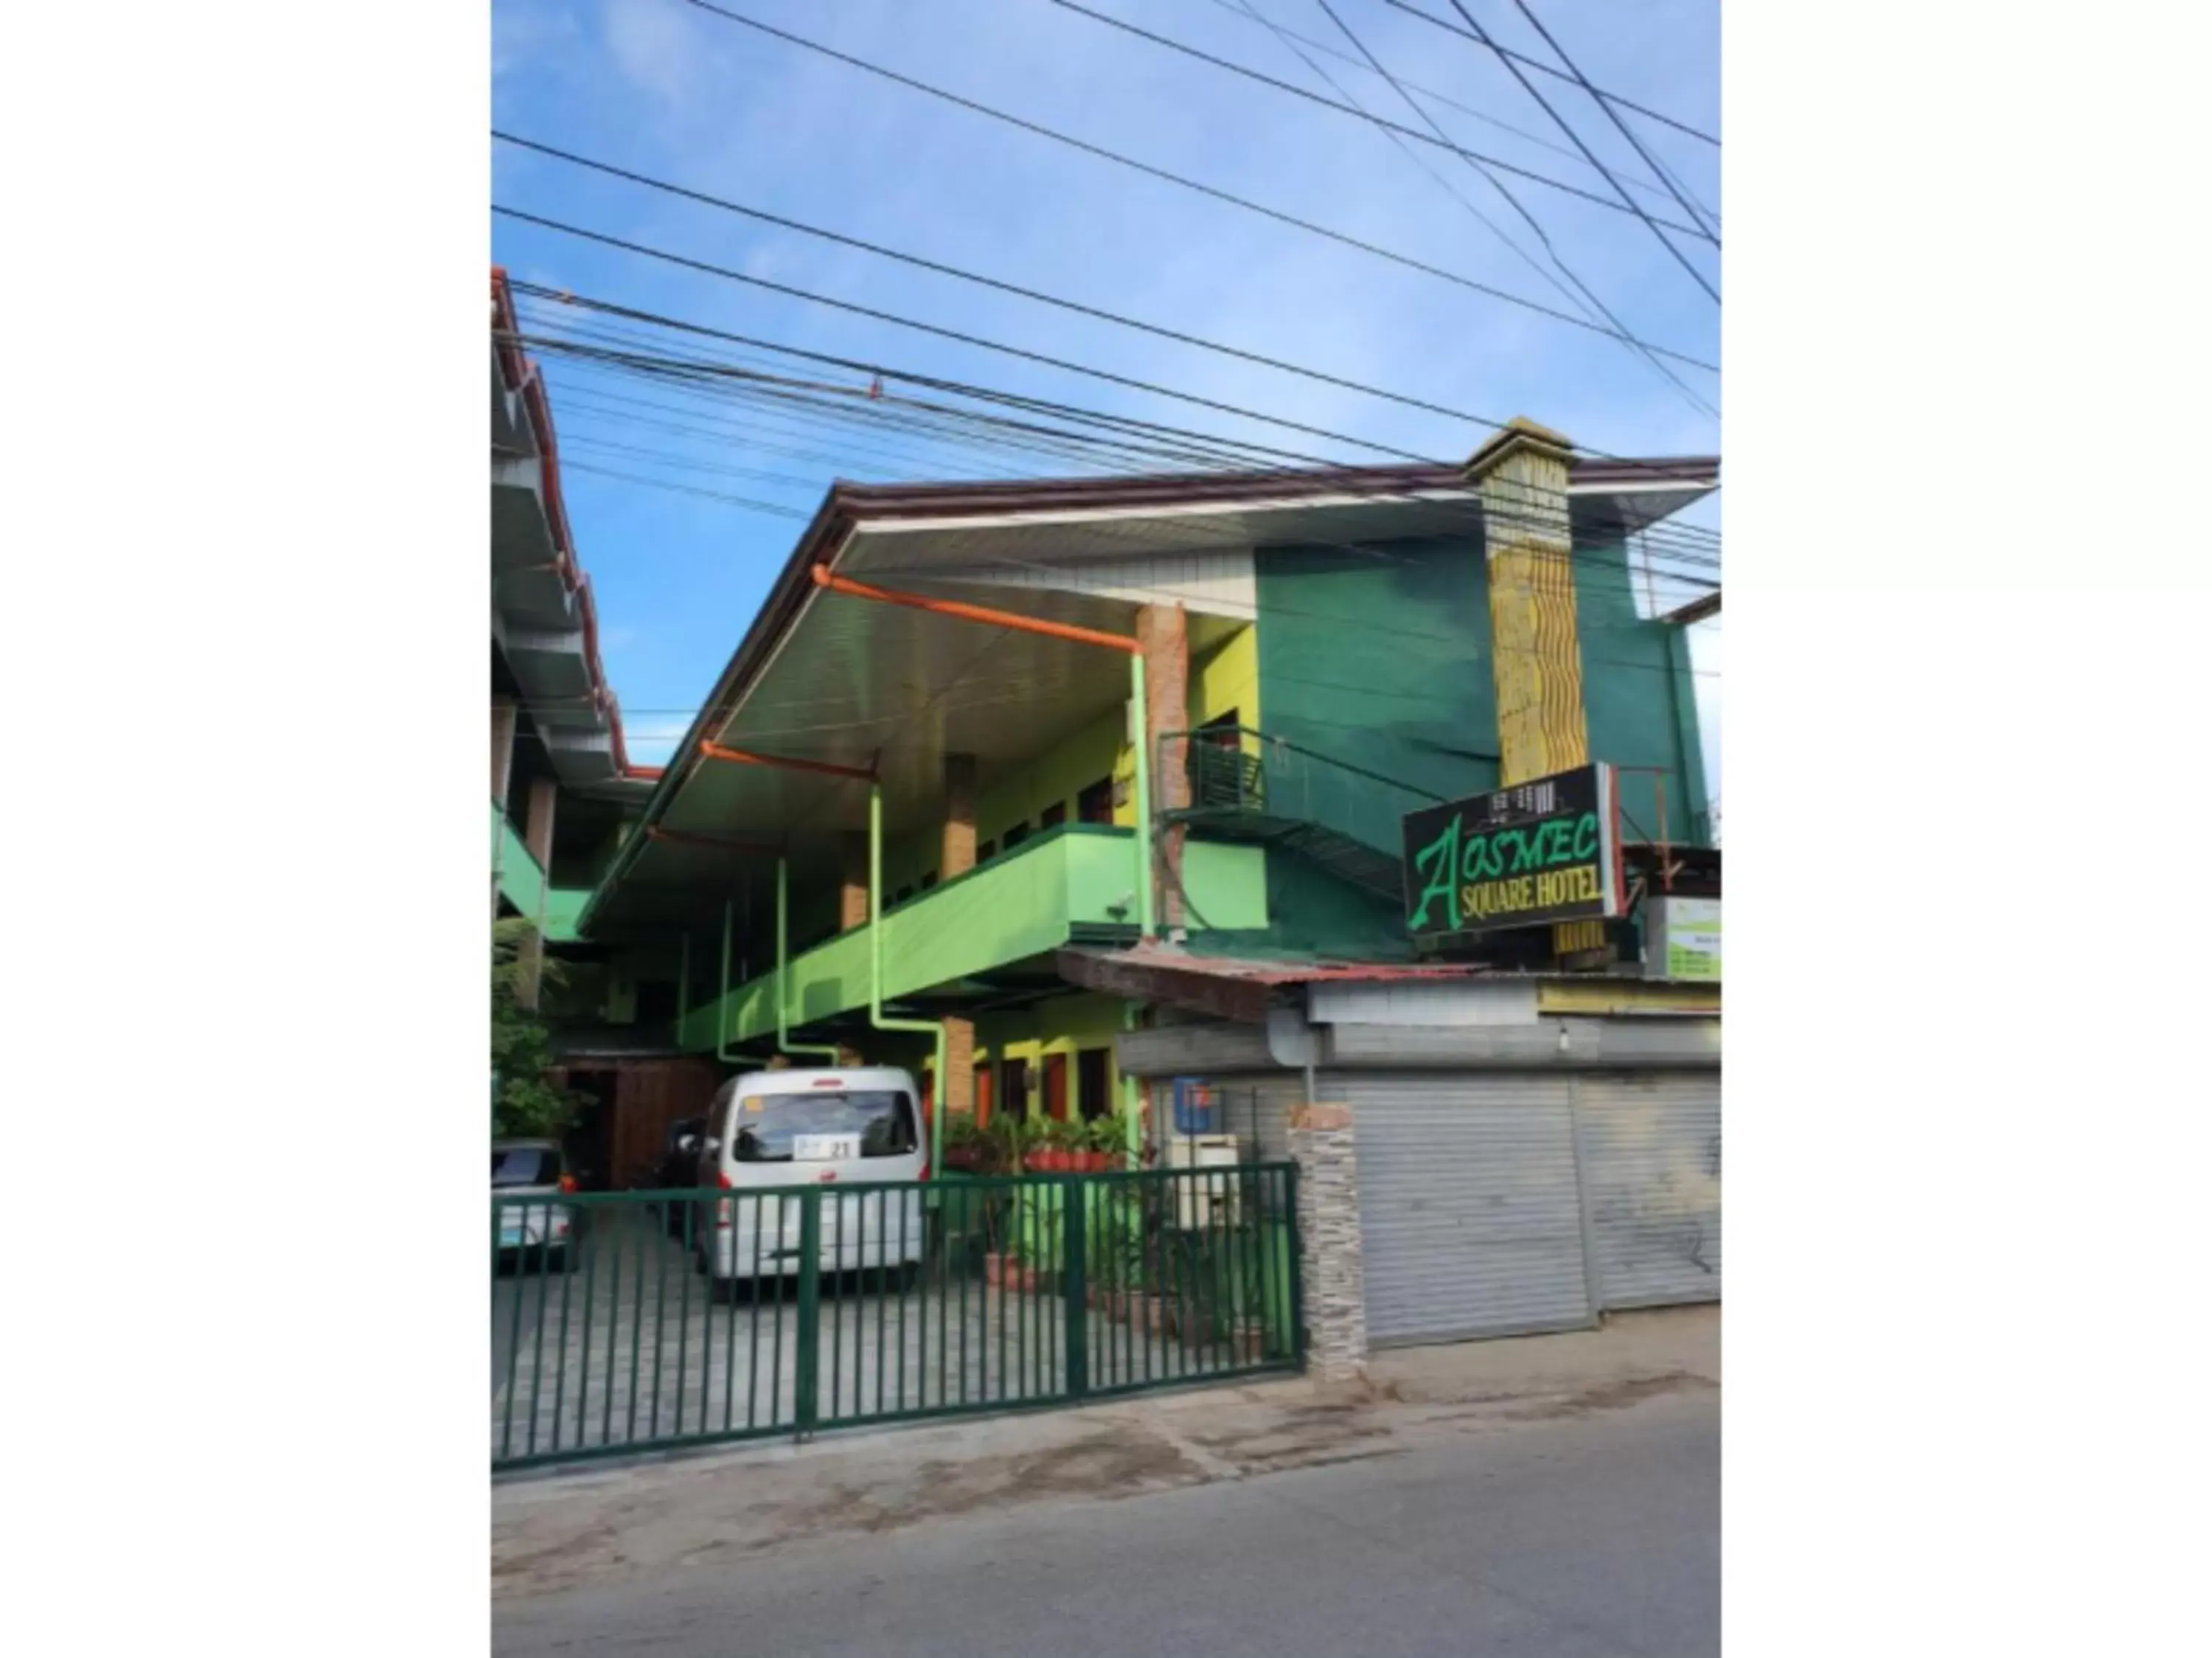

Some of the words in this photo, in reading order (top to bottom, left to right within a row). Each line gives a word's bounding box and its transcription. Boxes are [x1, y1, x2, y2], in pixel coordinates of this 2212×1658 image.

[1407, 813, 1598, 930] AOSMEC
[1461, 875, 1534, 920] SQUARE
[1536, 864, 1603, 907] HOTEL
